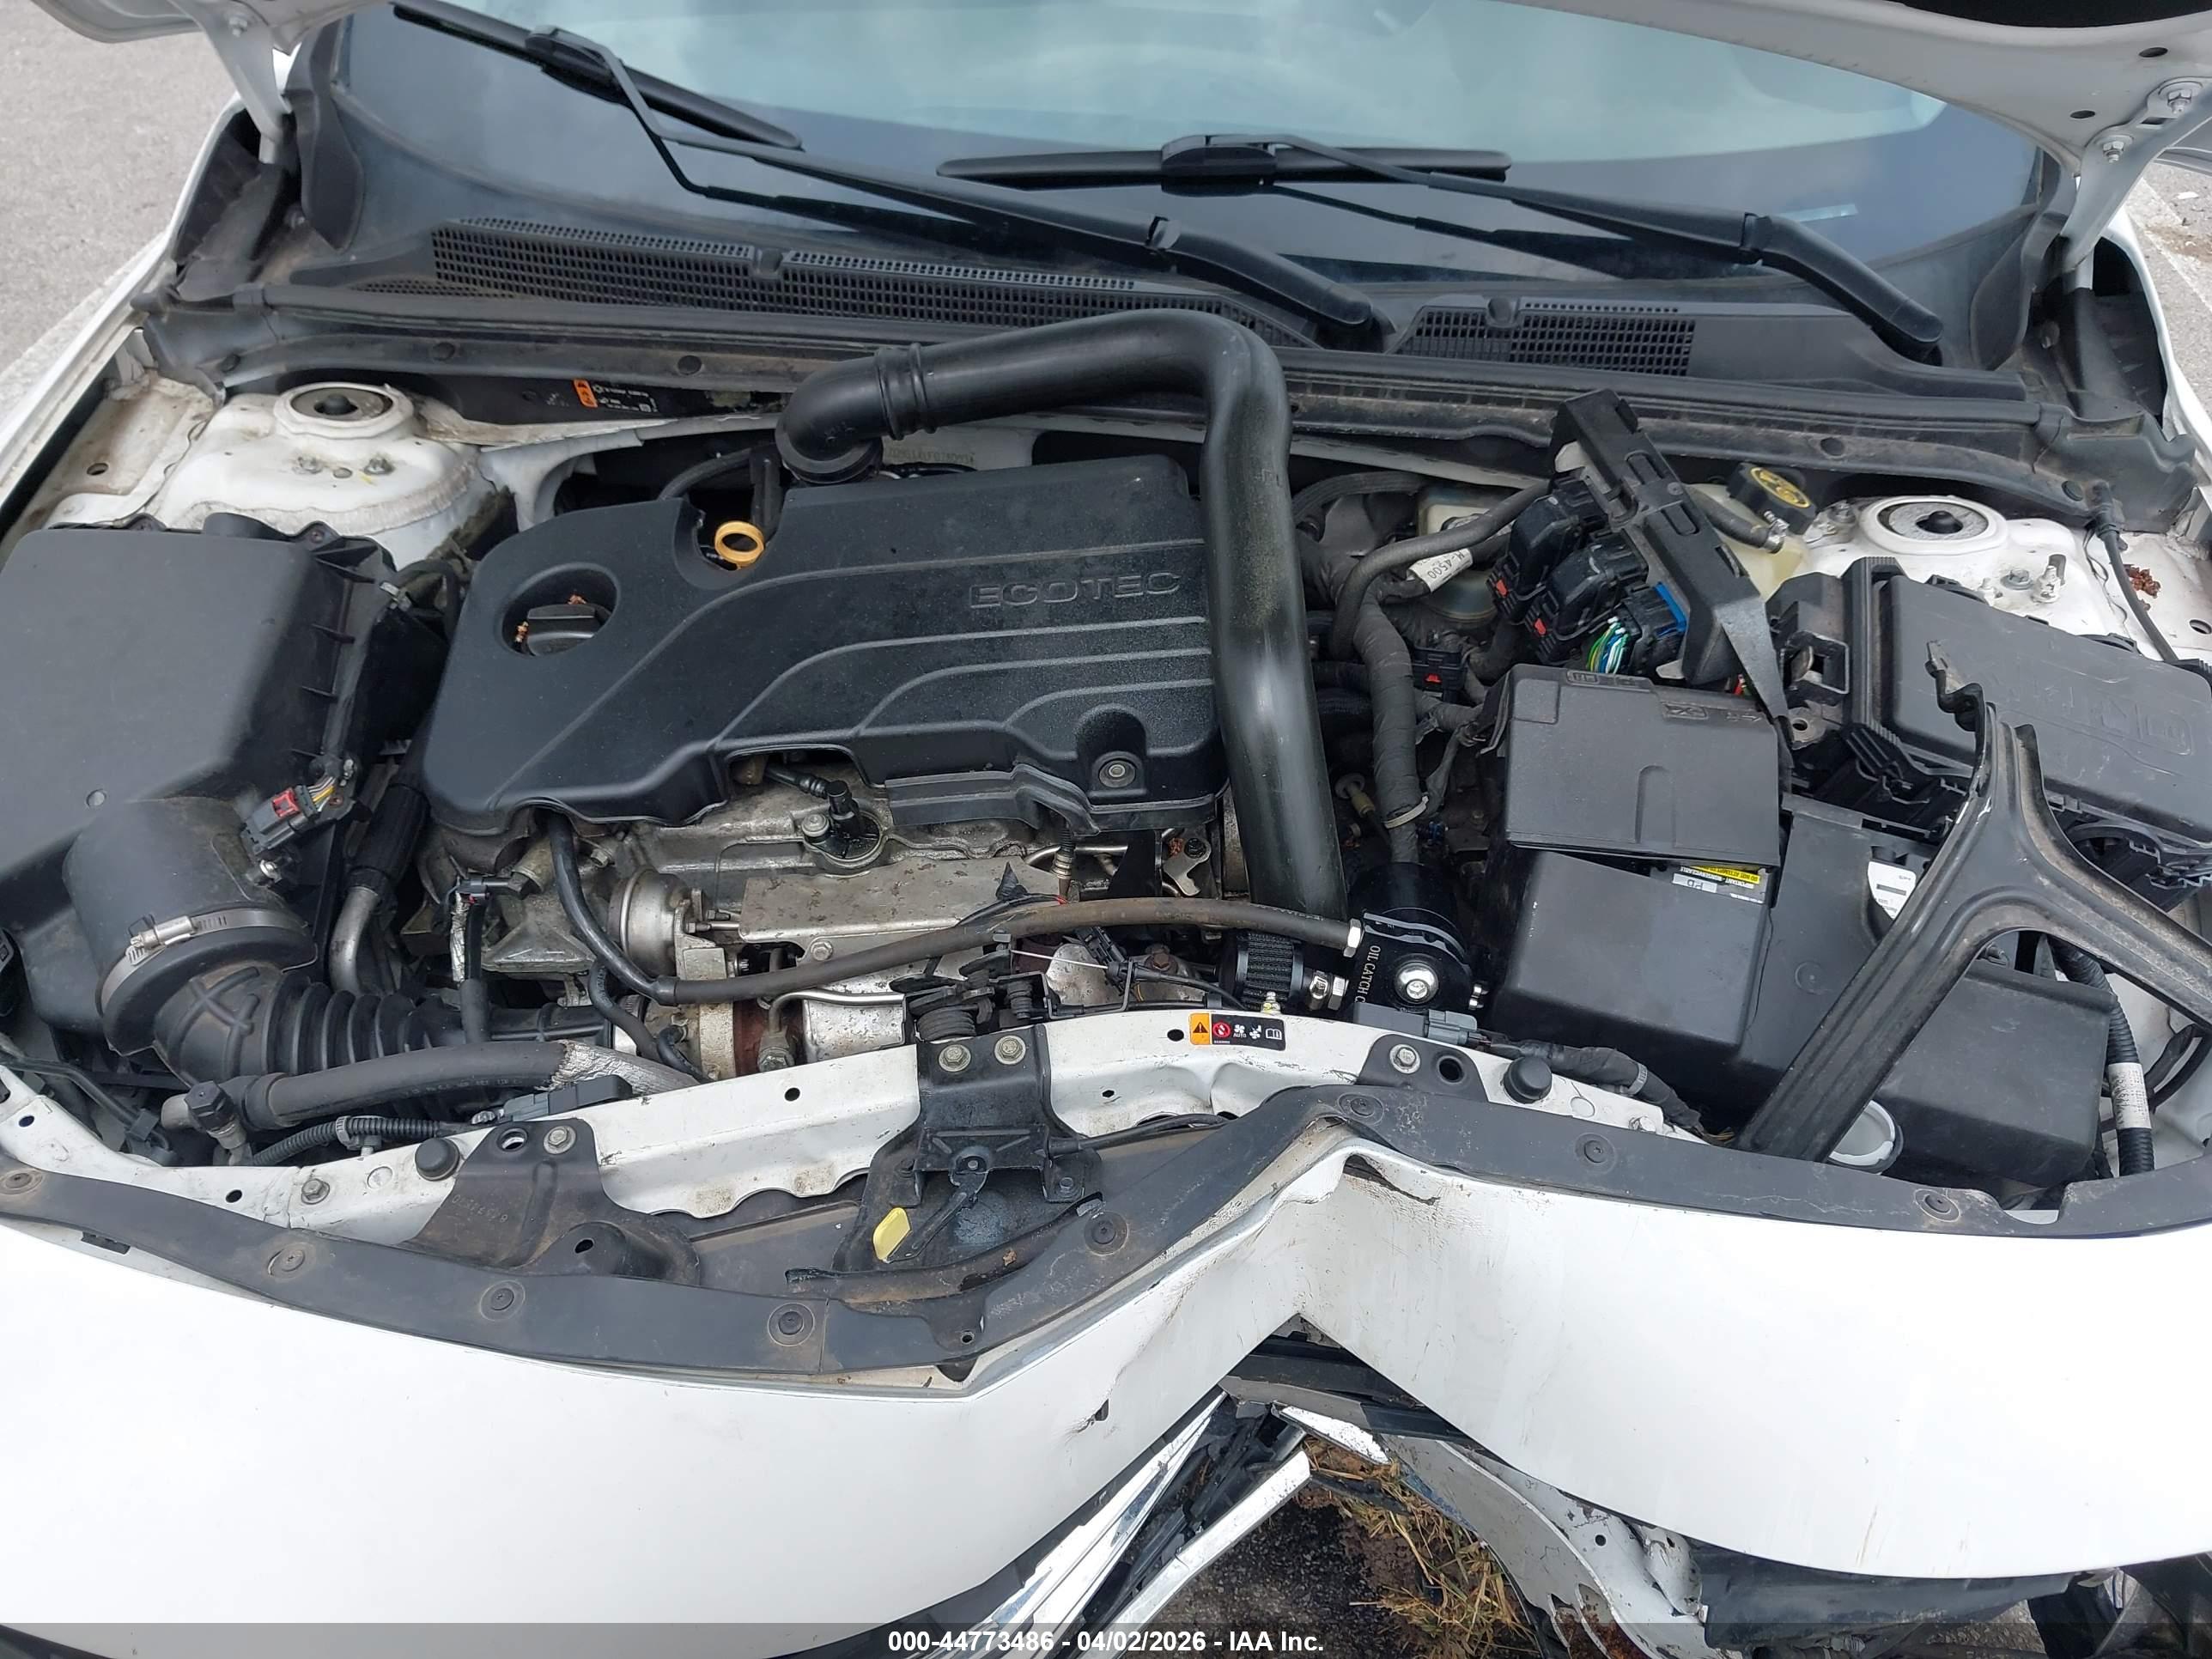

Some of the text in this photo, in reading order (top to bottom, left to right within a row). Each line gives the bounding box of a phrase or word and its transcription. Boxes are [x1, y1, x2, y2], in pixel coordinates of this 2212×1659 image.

[969, 572, 1181, 609] ECOTEC
[1366, 945, 1381, 962] OIL
[1357, 963, 1376, 995] CATCH
